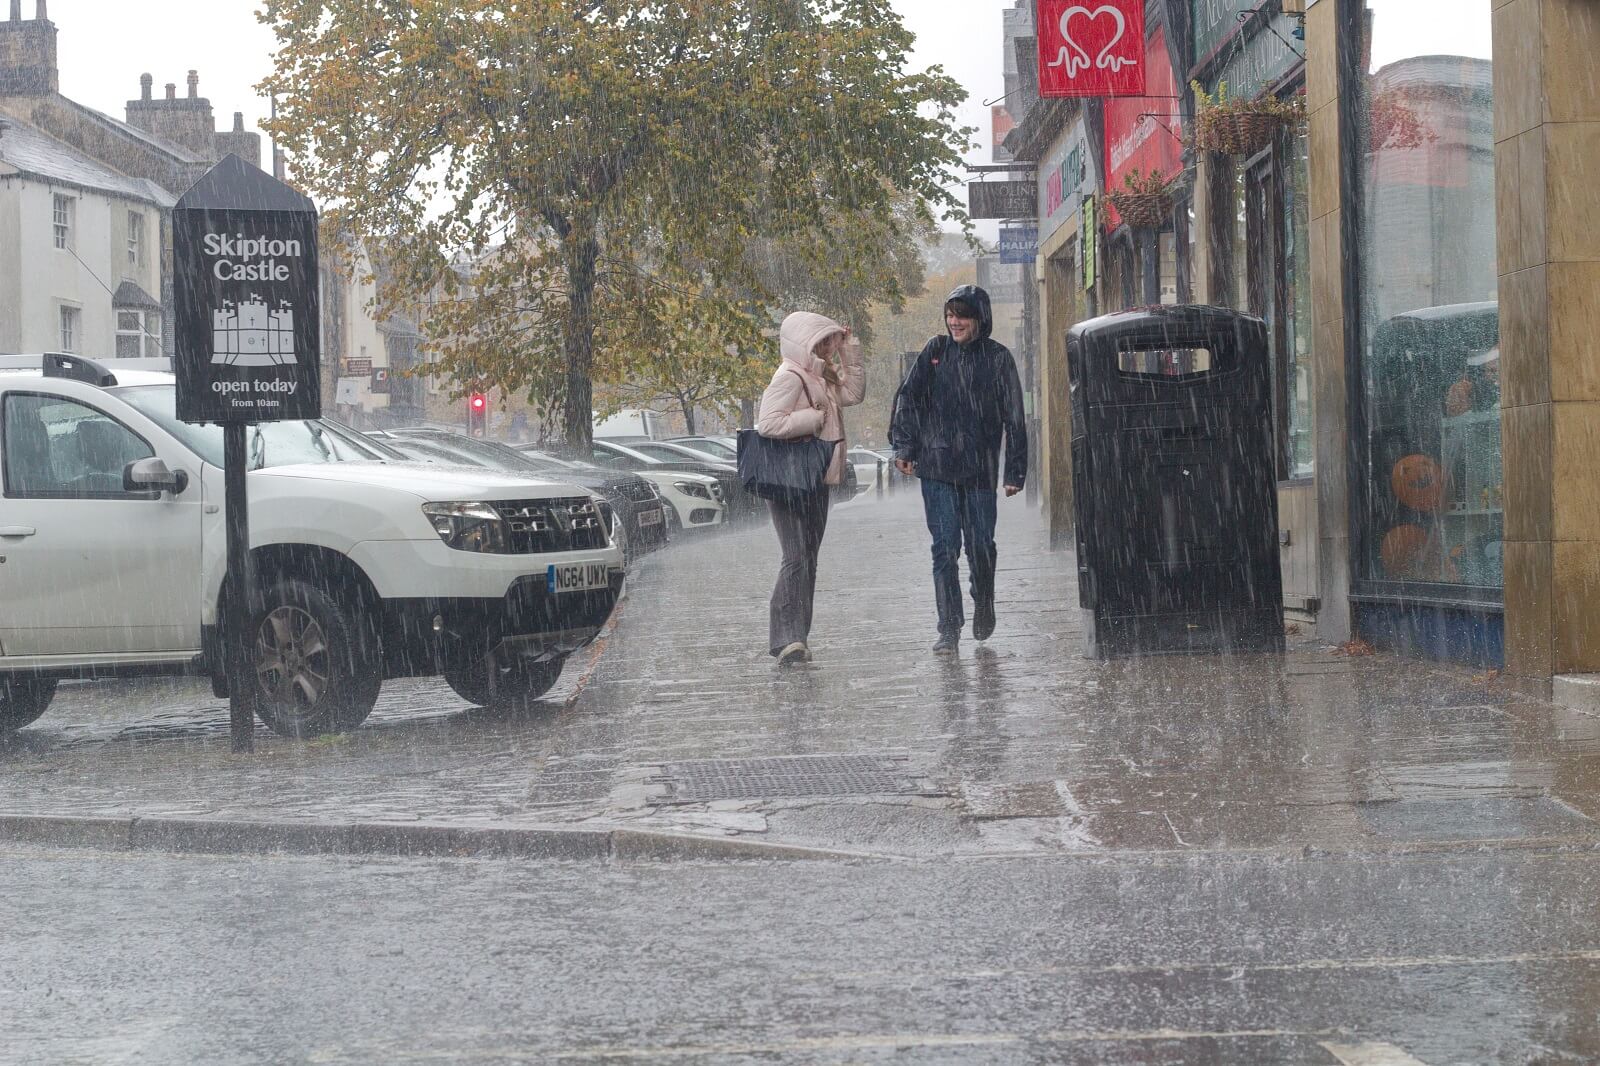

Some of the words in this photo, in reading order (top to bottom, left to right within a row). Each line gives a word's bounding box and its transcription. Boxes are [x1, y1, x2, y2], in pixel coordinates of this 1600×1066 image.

[203, 232, 301, 262] Skipton
[1001, 241, 1039, 250] HALIFA
[213, 258, 290, 281] Castle
[211, 380, 250, 395] open
[253, 377, 298, 395] today
[231, 398, 254, 407] from
[256, 398, 280, 407] 10am
[556, 566, 584, 588] NG64
[586, 564, 607, 586] UWX
